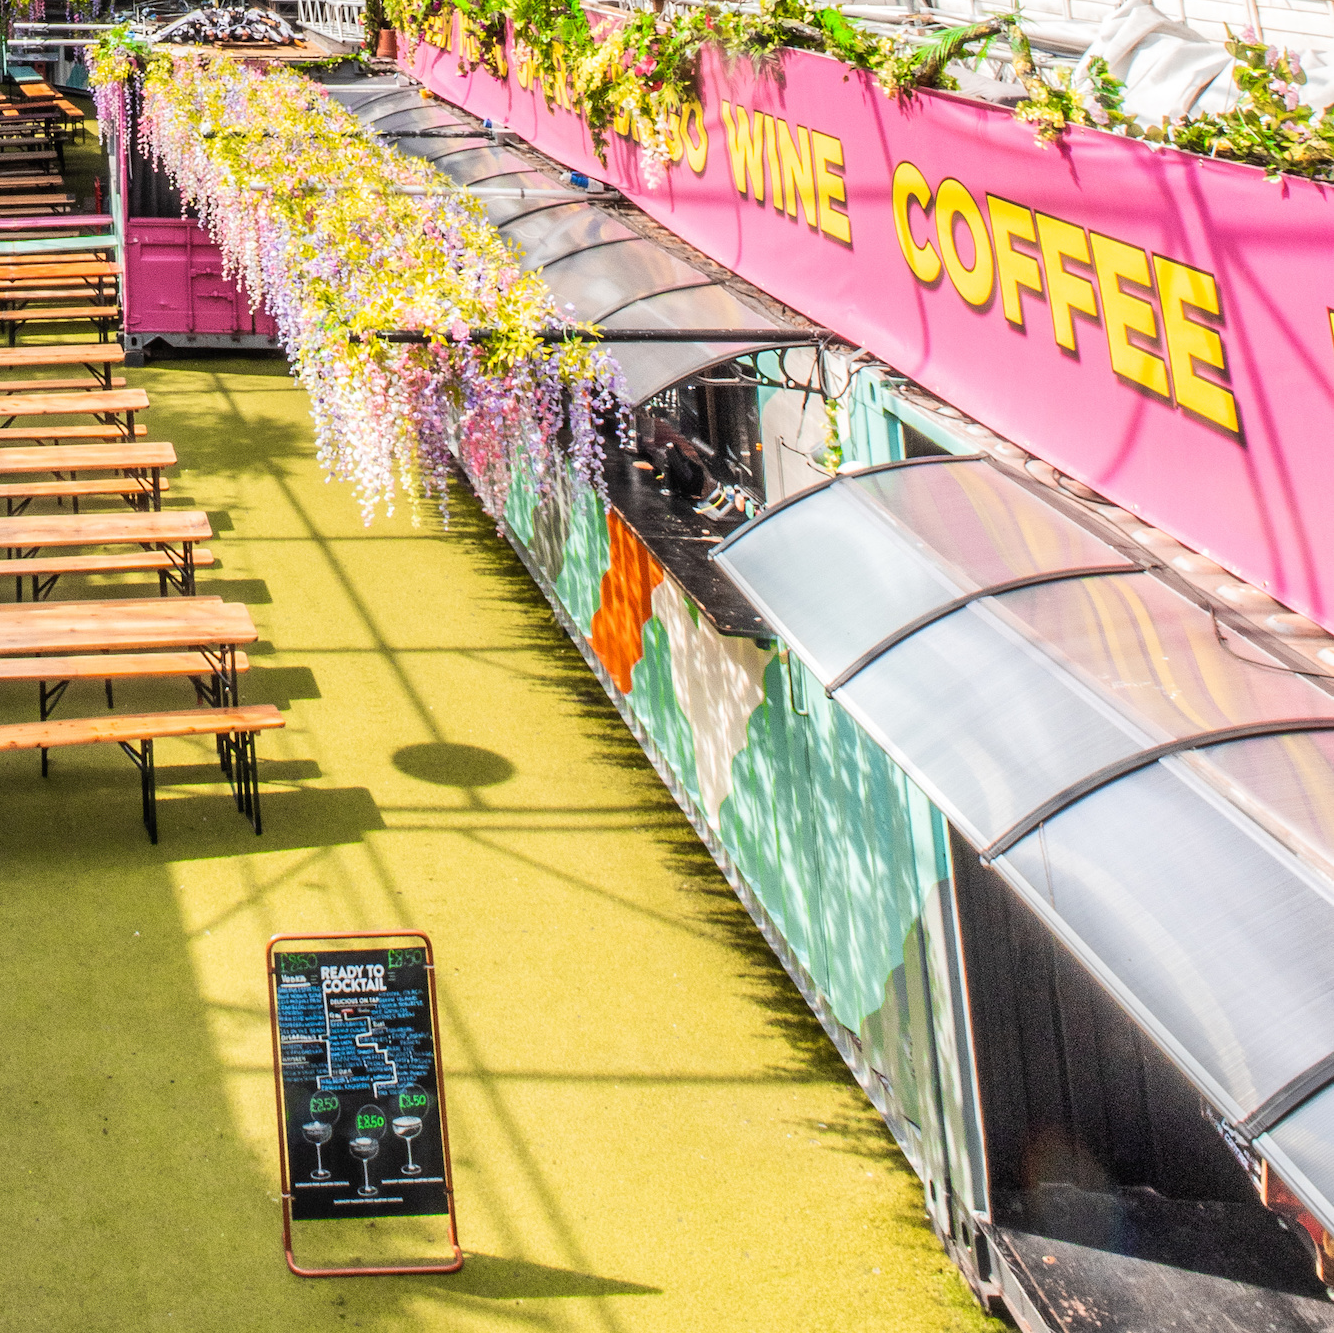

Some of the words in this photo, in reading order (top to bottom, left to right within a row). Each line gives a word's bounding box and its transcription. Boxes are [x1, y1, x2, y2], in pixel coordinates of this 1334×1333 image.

[722, 99, 853, 249] WINE
[891, 160, 1244, 445] COFFEE
[320, 965, 364, 980] READY
[366, 964, 385, 978] TO
[322, 977, 387, 993] COCKTAIL
